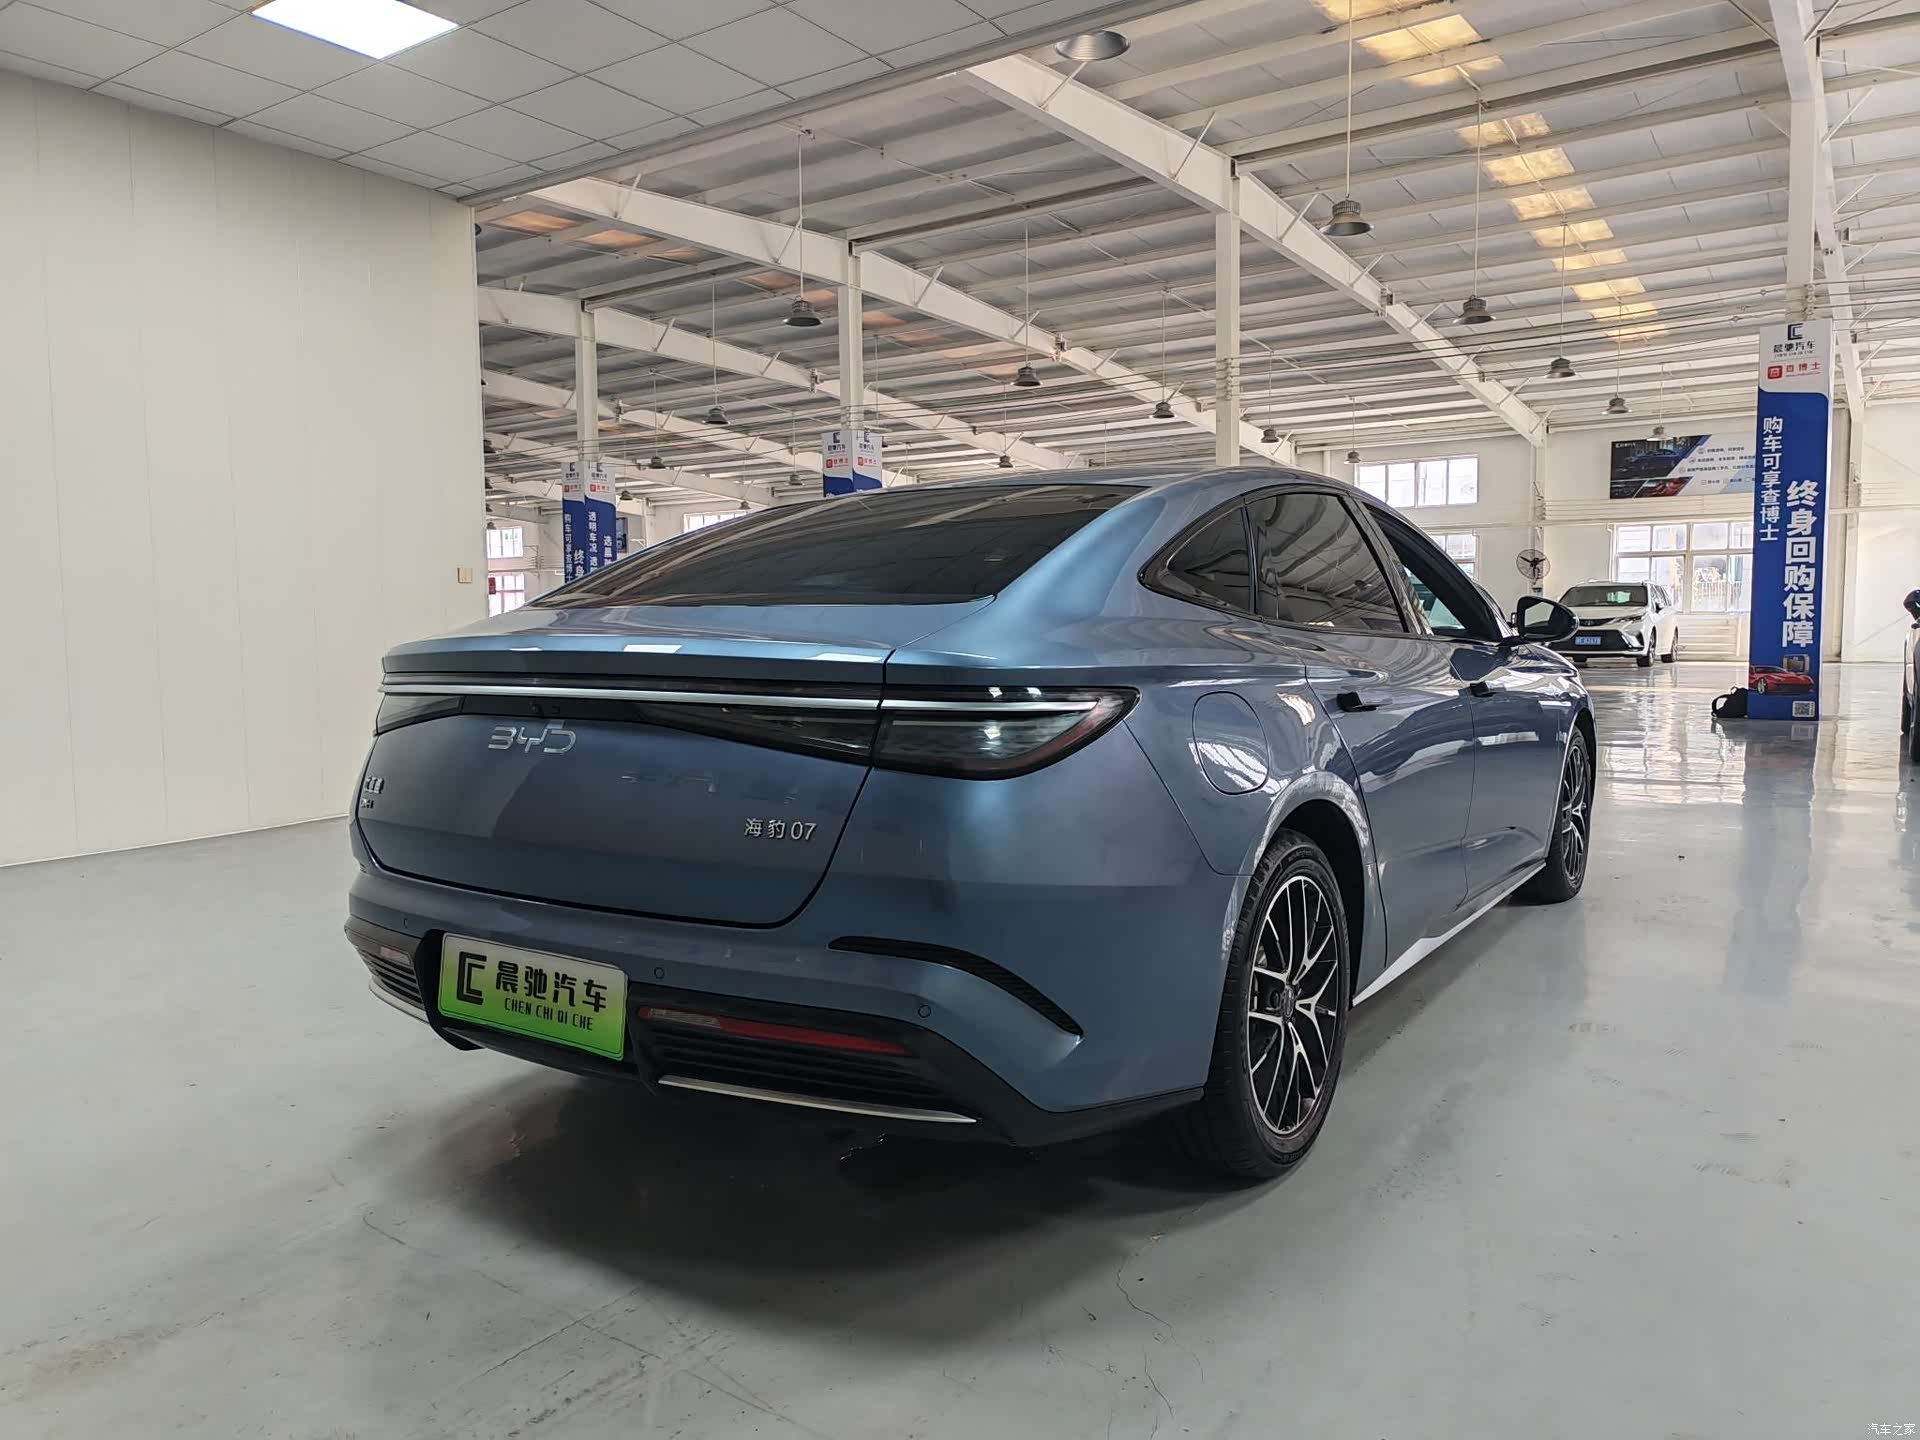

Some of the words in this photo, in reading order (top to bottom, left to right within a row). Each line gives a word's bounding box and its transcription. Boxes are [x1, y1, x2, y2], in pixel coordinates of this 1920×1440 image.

[1759, 416, 1784, 541] 购车可享查博士
[1781, 479, 1819, 648] 终身回购保障
[488, 726, 576, 754] BYD
[496, 960, 607, 1013] 晨驰汽车
[504, 997, 532, 1015] CHEN
[536, 1004, 553, 1020] CHI
[572, 1013, 593, 1031] CHE
